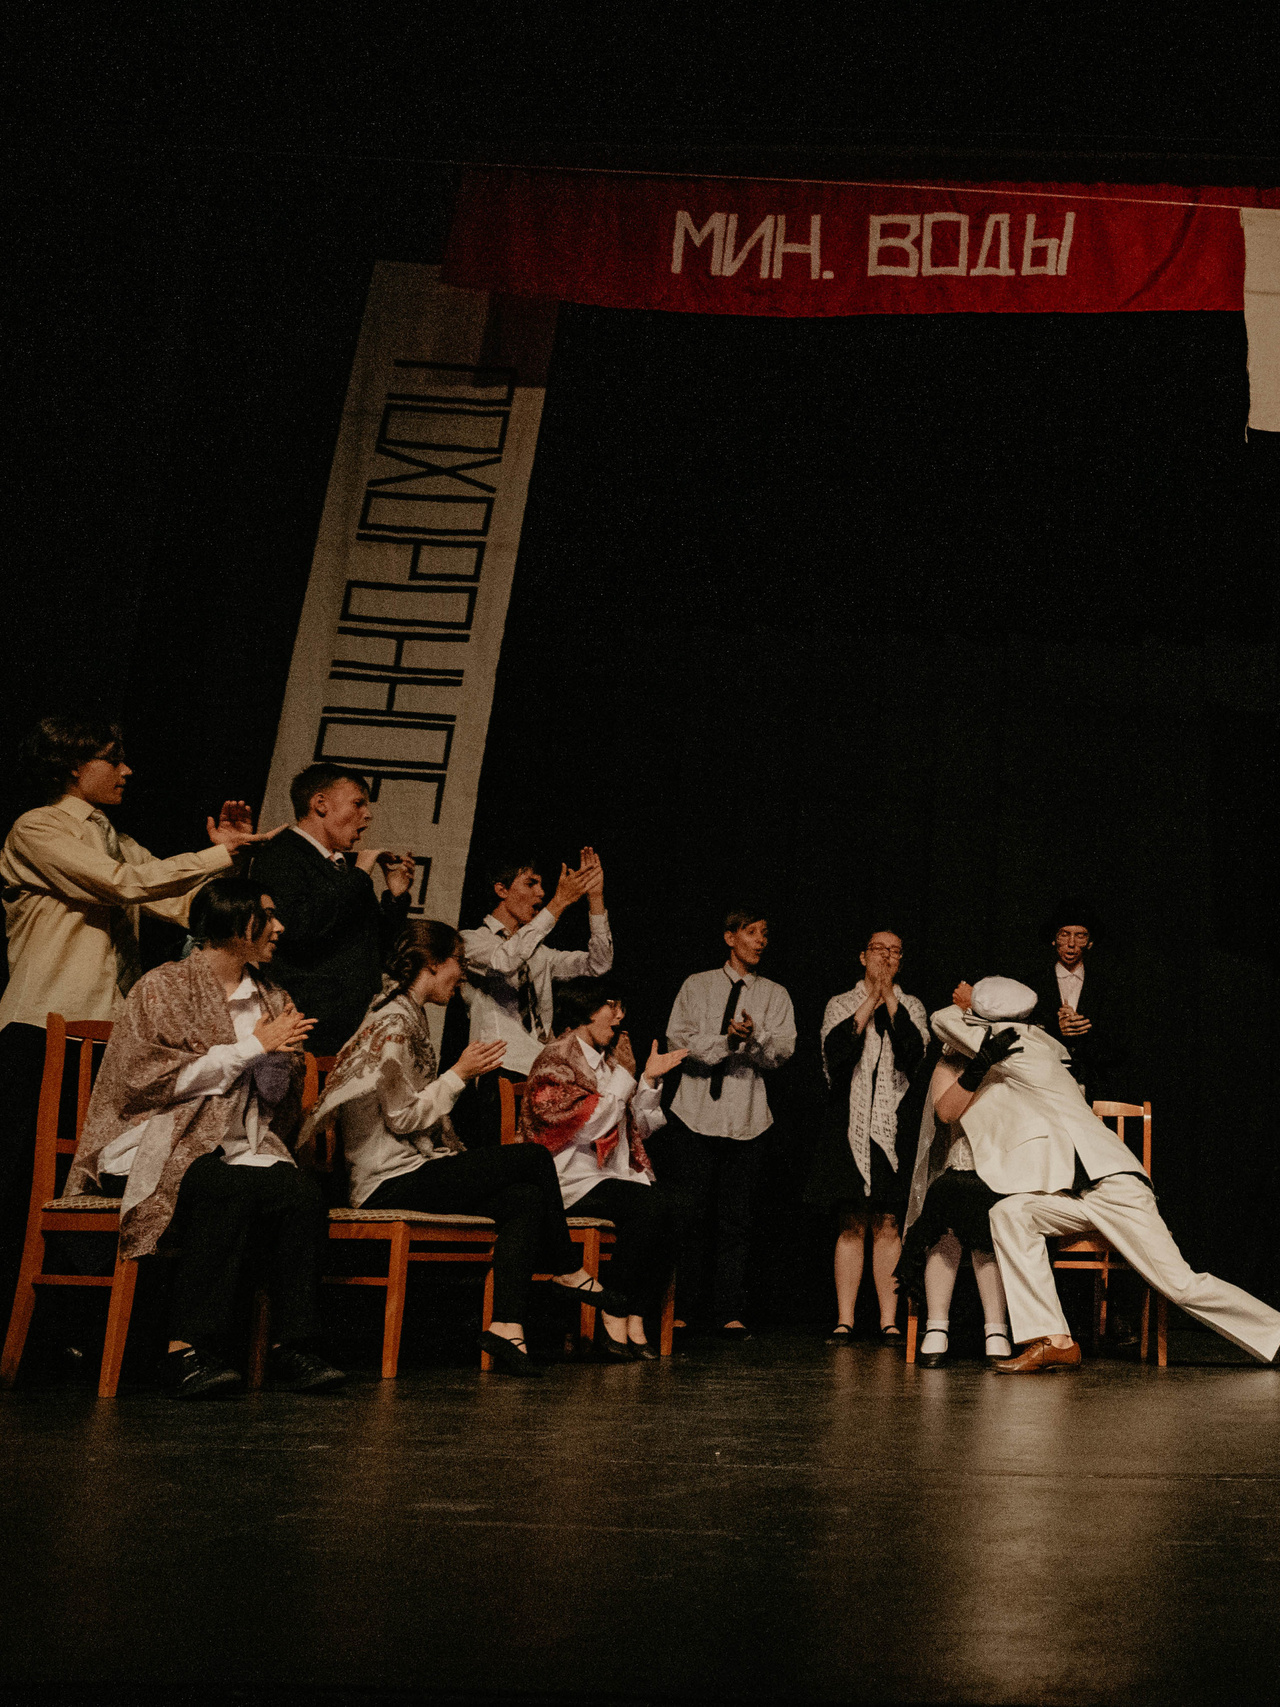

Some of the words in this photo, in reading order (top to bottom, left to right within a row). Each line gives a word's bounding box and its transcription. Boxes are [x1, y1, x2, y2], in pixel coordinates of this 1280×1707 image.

[671, 210, 834, 280] МИН.
[867, 211, 1076, 277] ВОДЫ
[313, 359, 517, 825] ПОХОРОННОЕ
